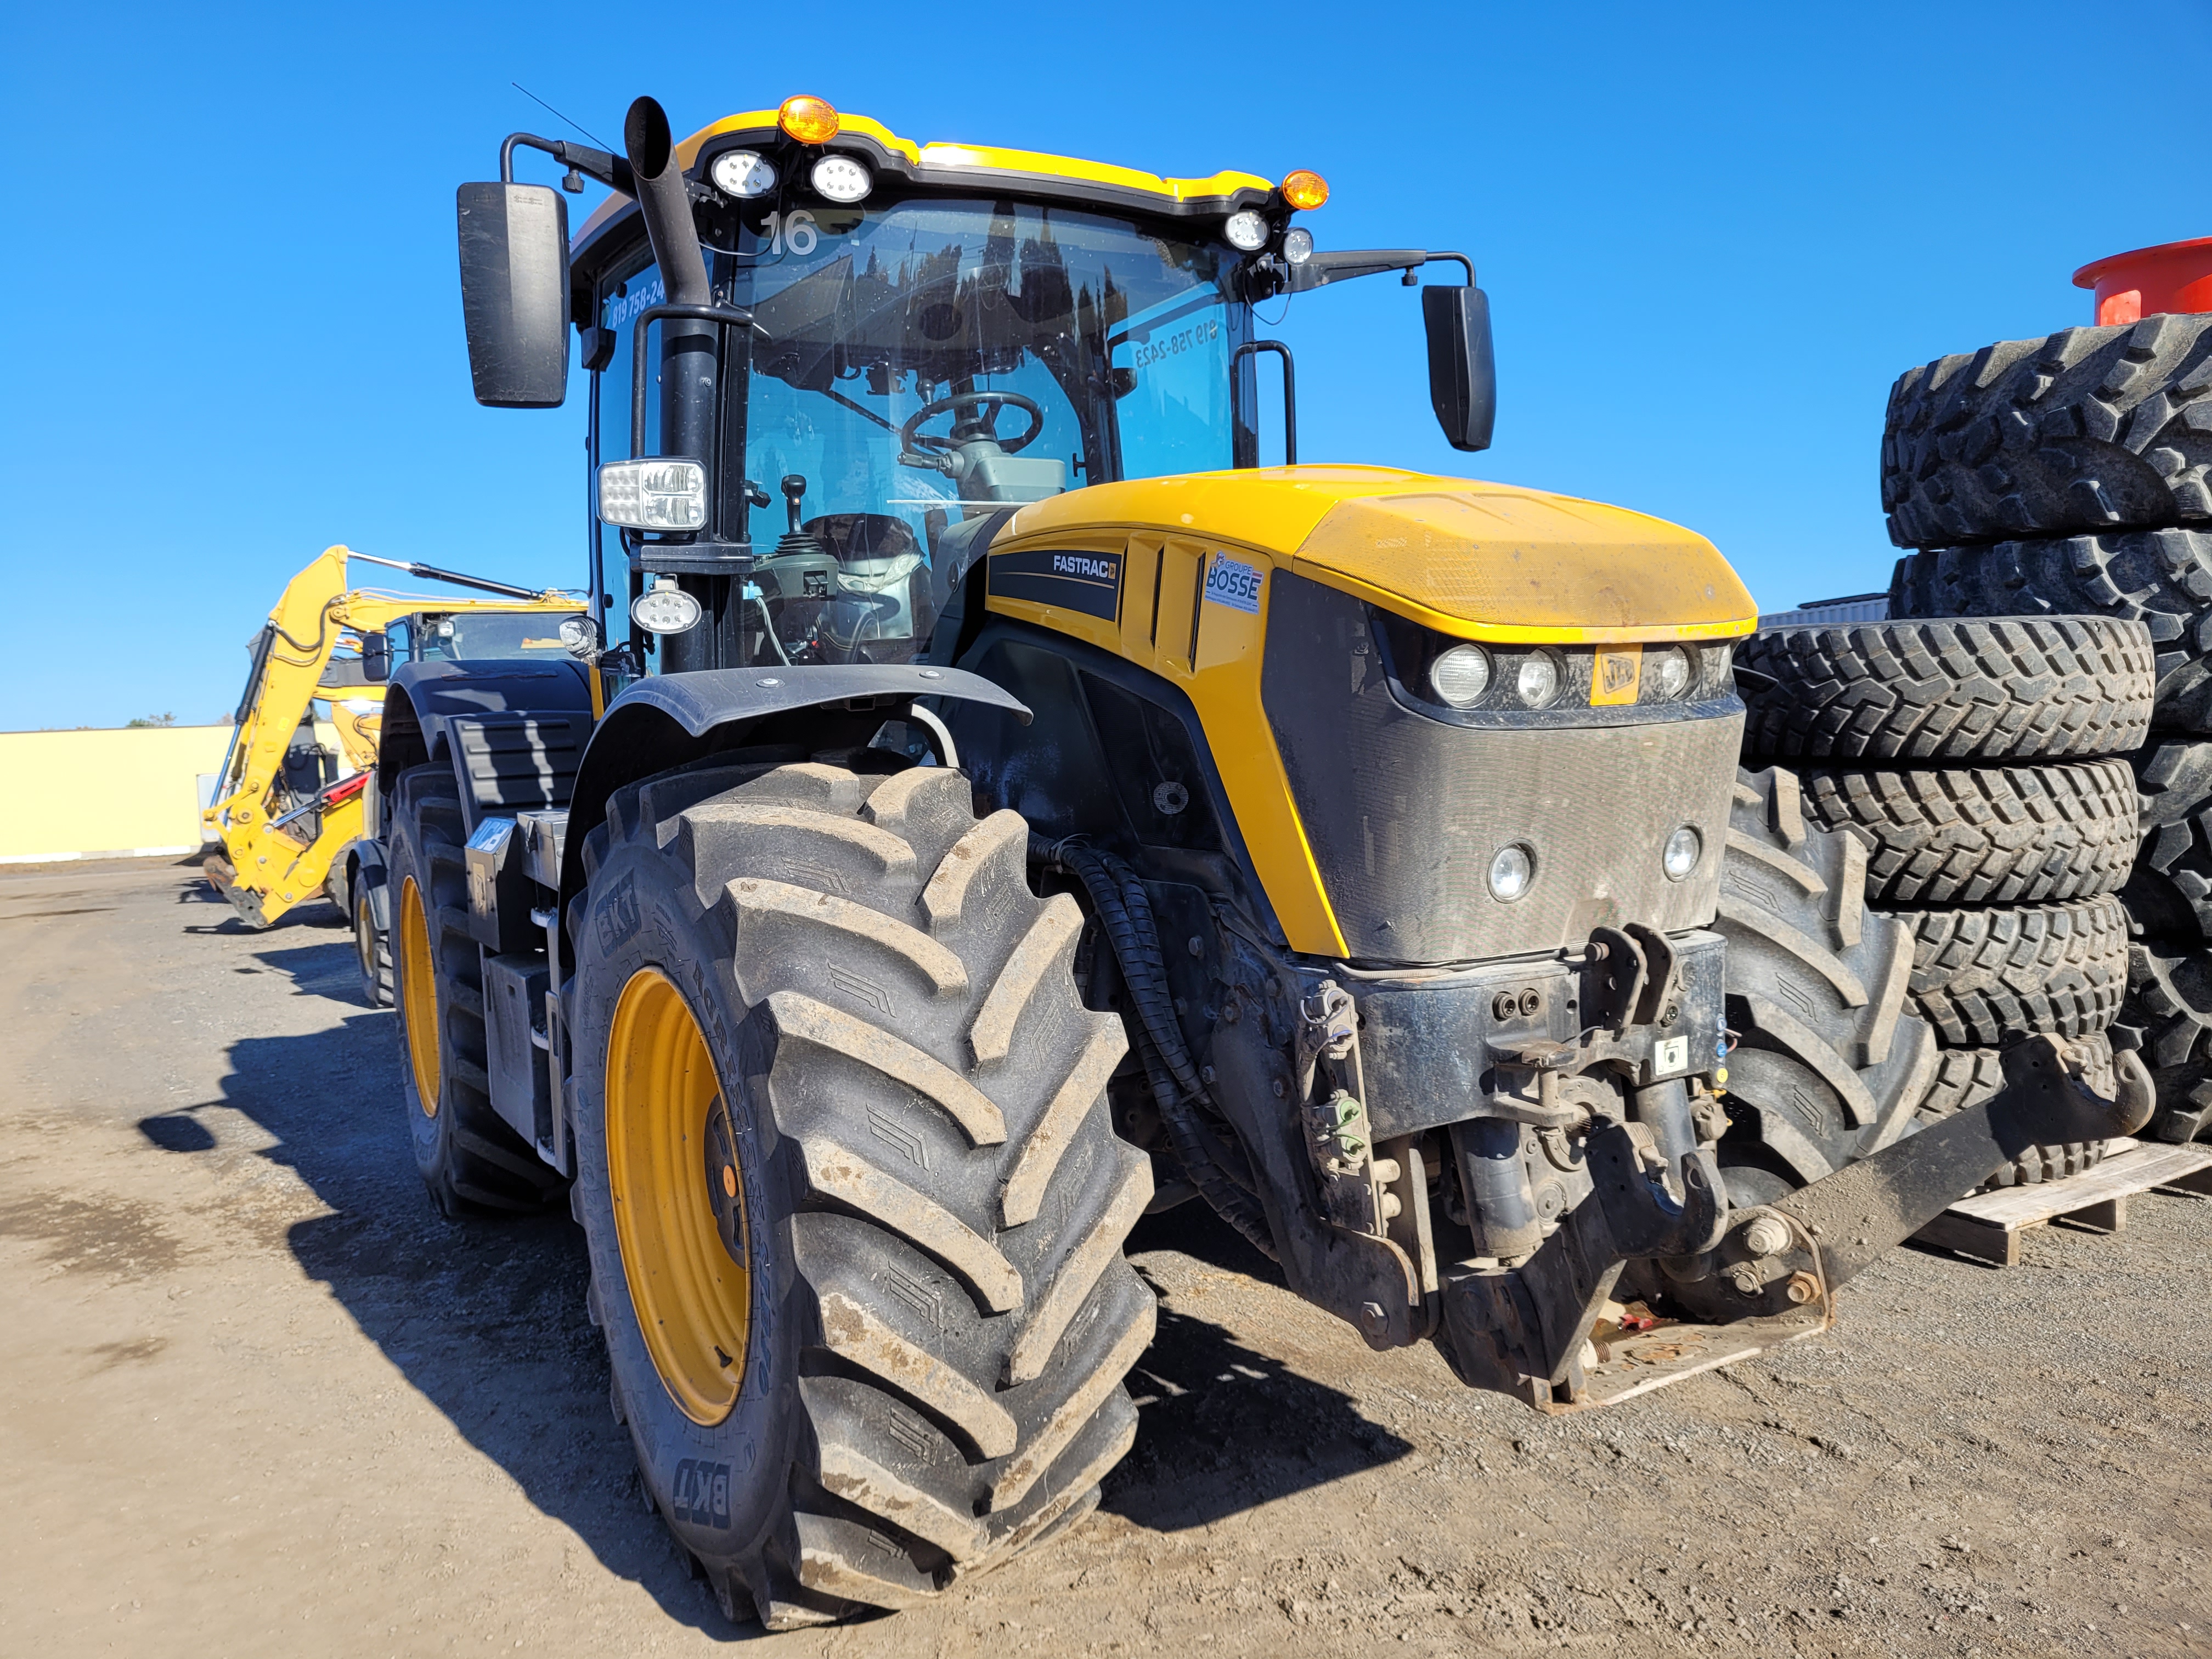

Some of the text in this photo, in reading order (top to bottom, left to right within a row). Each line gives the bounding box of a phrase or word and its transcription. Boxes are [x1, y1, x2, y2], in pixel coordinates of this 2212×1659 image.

[760, 210, 817, 255] 16
[613, 299, 627, 328] 819
[1053, 555, 1109, 578] FASTRAC
[1225, 561, 1253, 575] GROUPE
[1605, 659, 1633, 689] JCB
[596, 883, 637, 948] BKT
[674, 1467, 728, 1516] BKT
